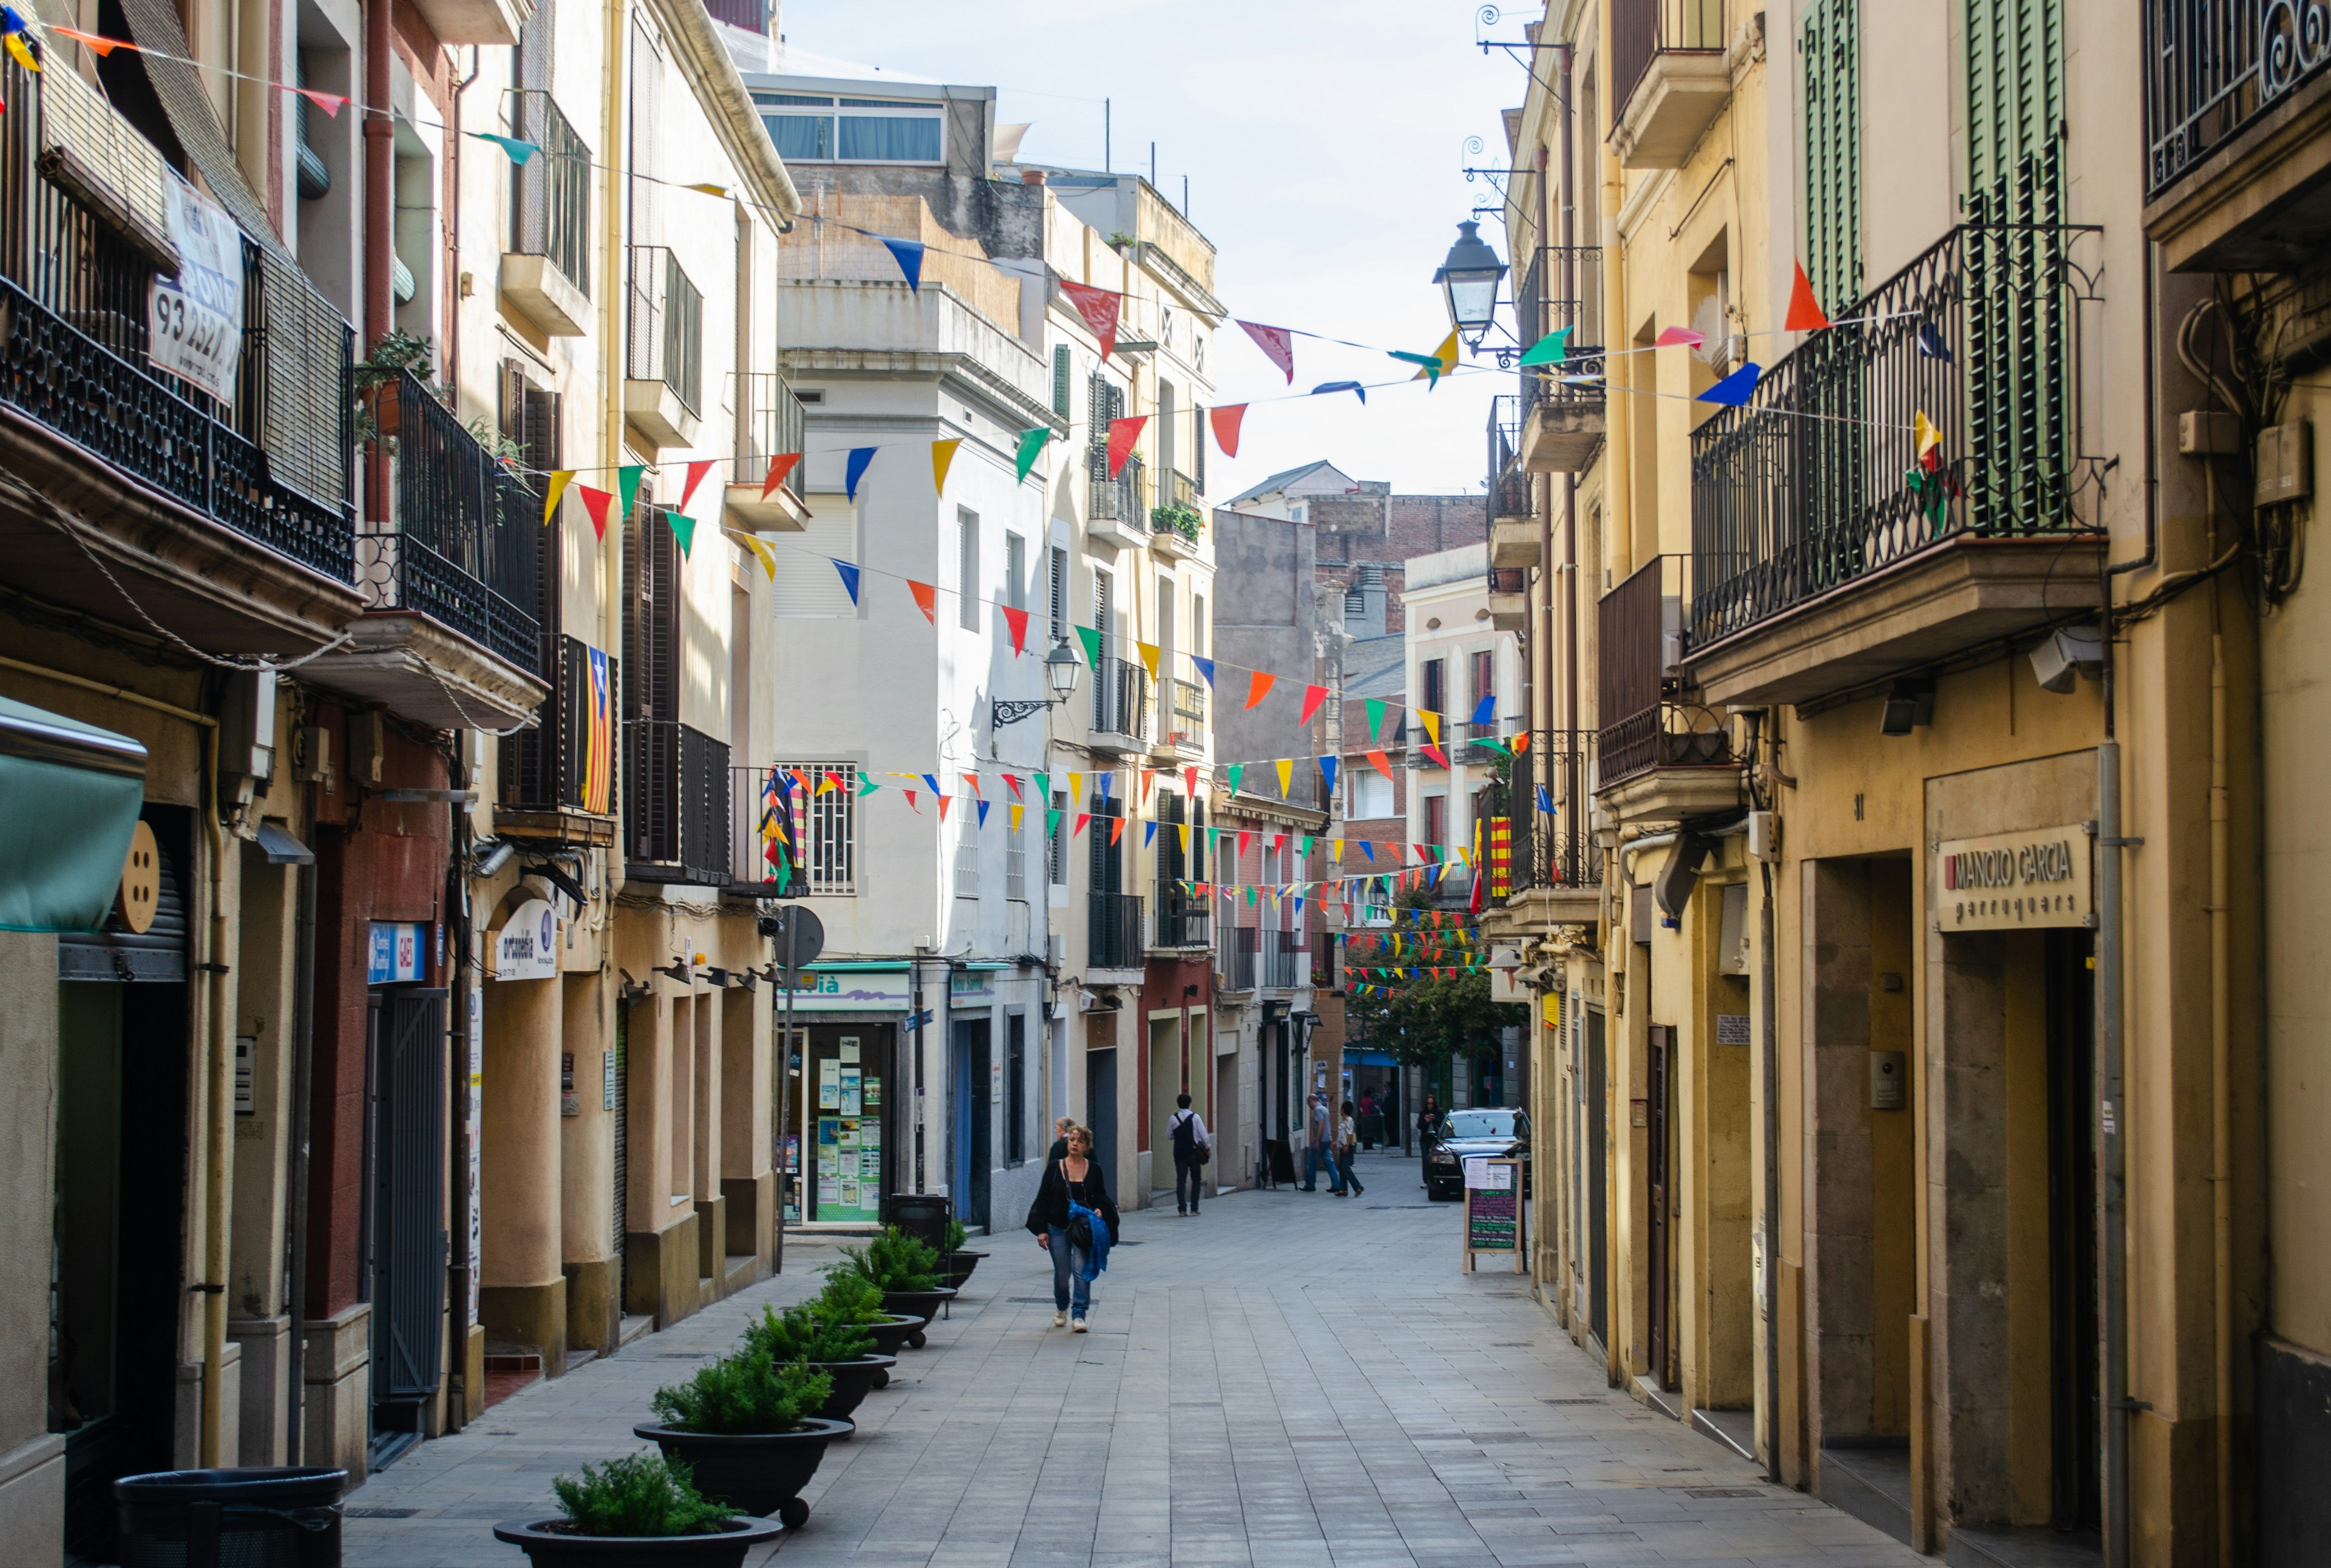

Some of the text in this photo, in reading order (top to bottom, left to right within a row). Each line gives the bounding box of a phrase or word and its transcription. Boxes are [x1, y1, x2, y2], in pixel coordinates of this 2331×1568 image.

[1955, 840, 2073, 889] MANOLO GARCIA
[1956, 894, 2074, 925] perruquers
[399, 937, 412, 968] GAES
